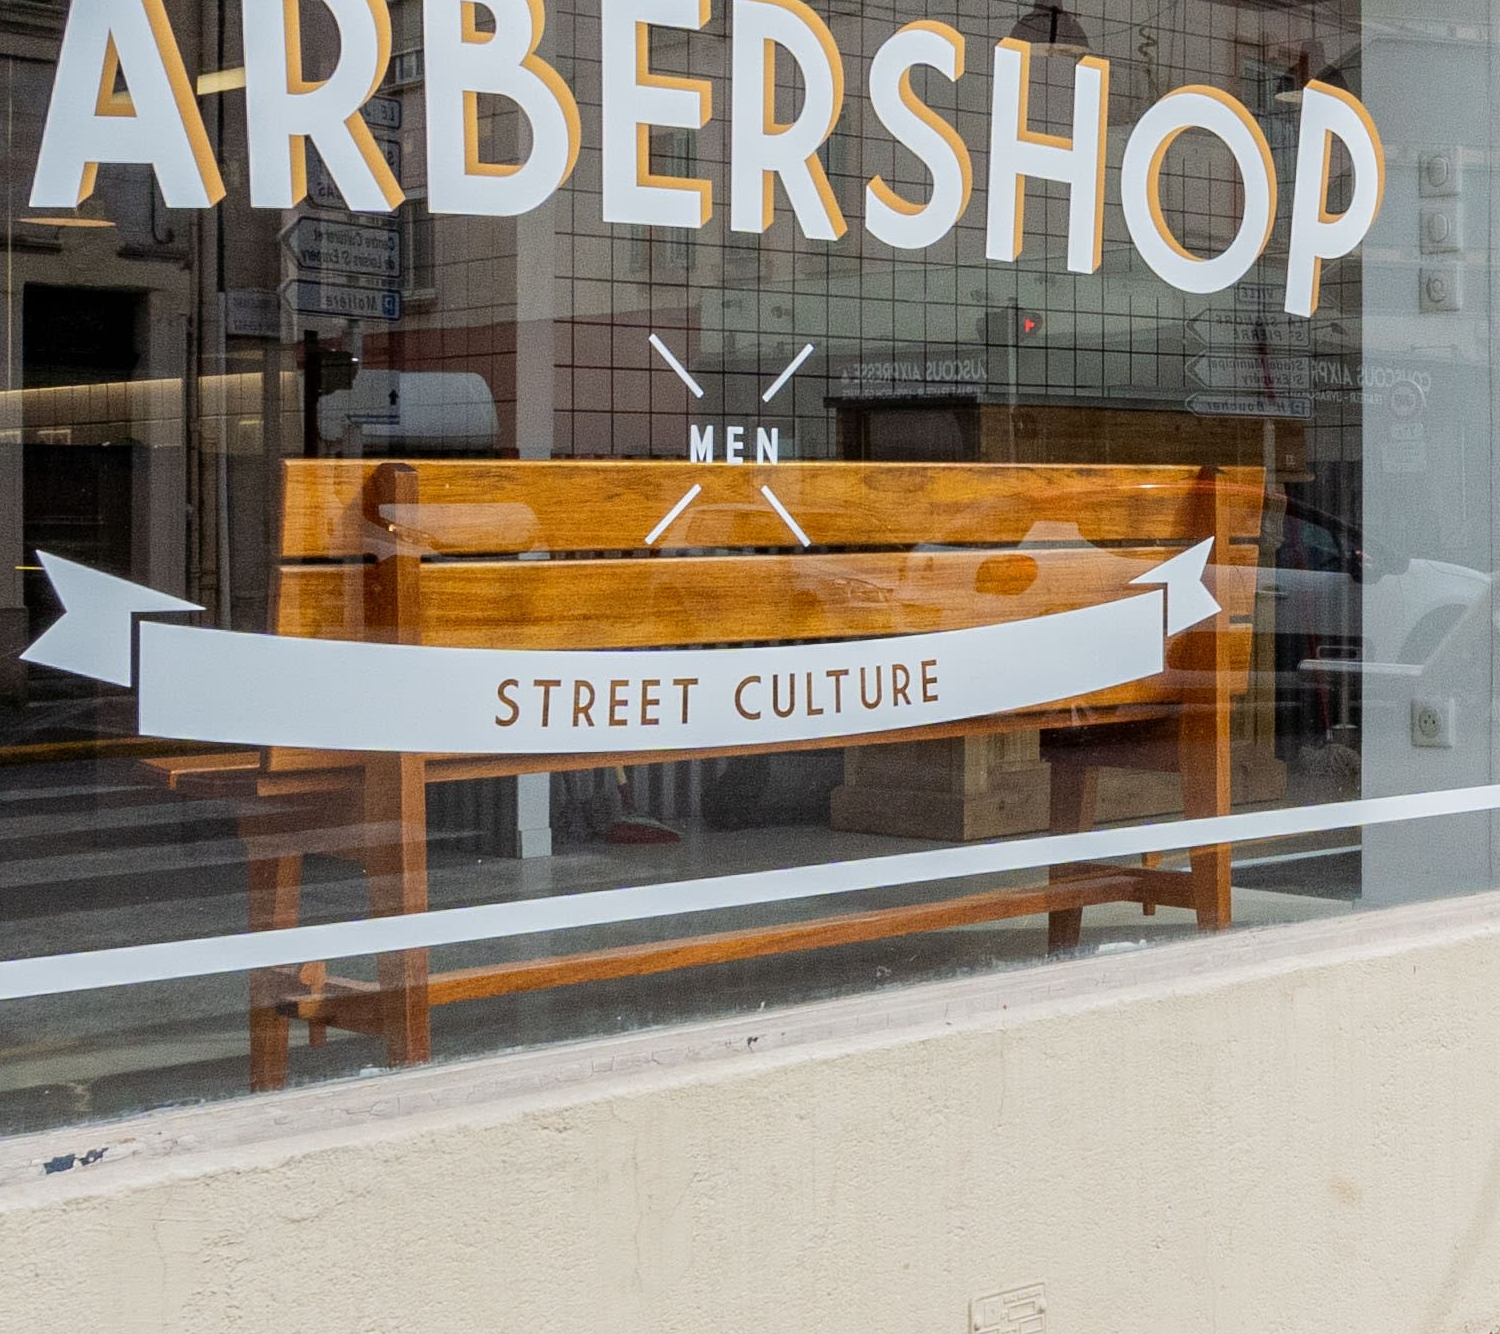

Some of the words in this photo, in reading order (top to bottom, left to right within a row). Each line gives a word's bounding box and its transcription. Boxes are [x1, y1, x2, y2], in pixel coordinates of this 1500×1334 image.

[690, 424, 778, 465] MEN
[495, 678, 698, 727] STREET
[735, 658, 939, 721] CULTURE
